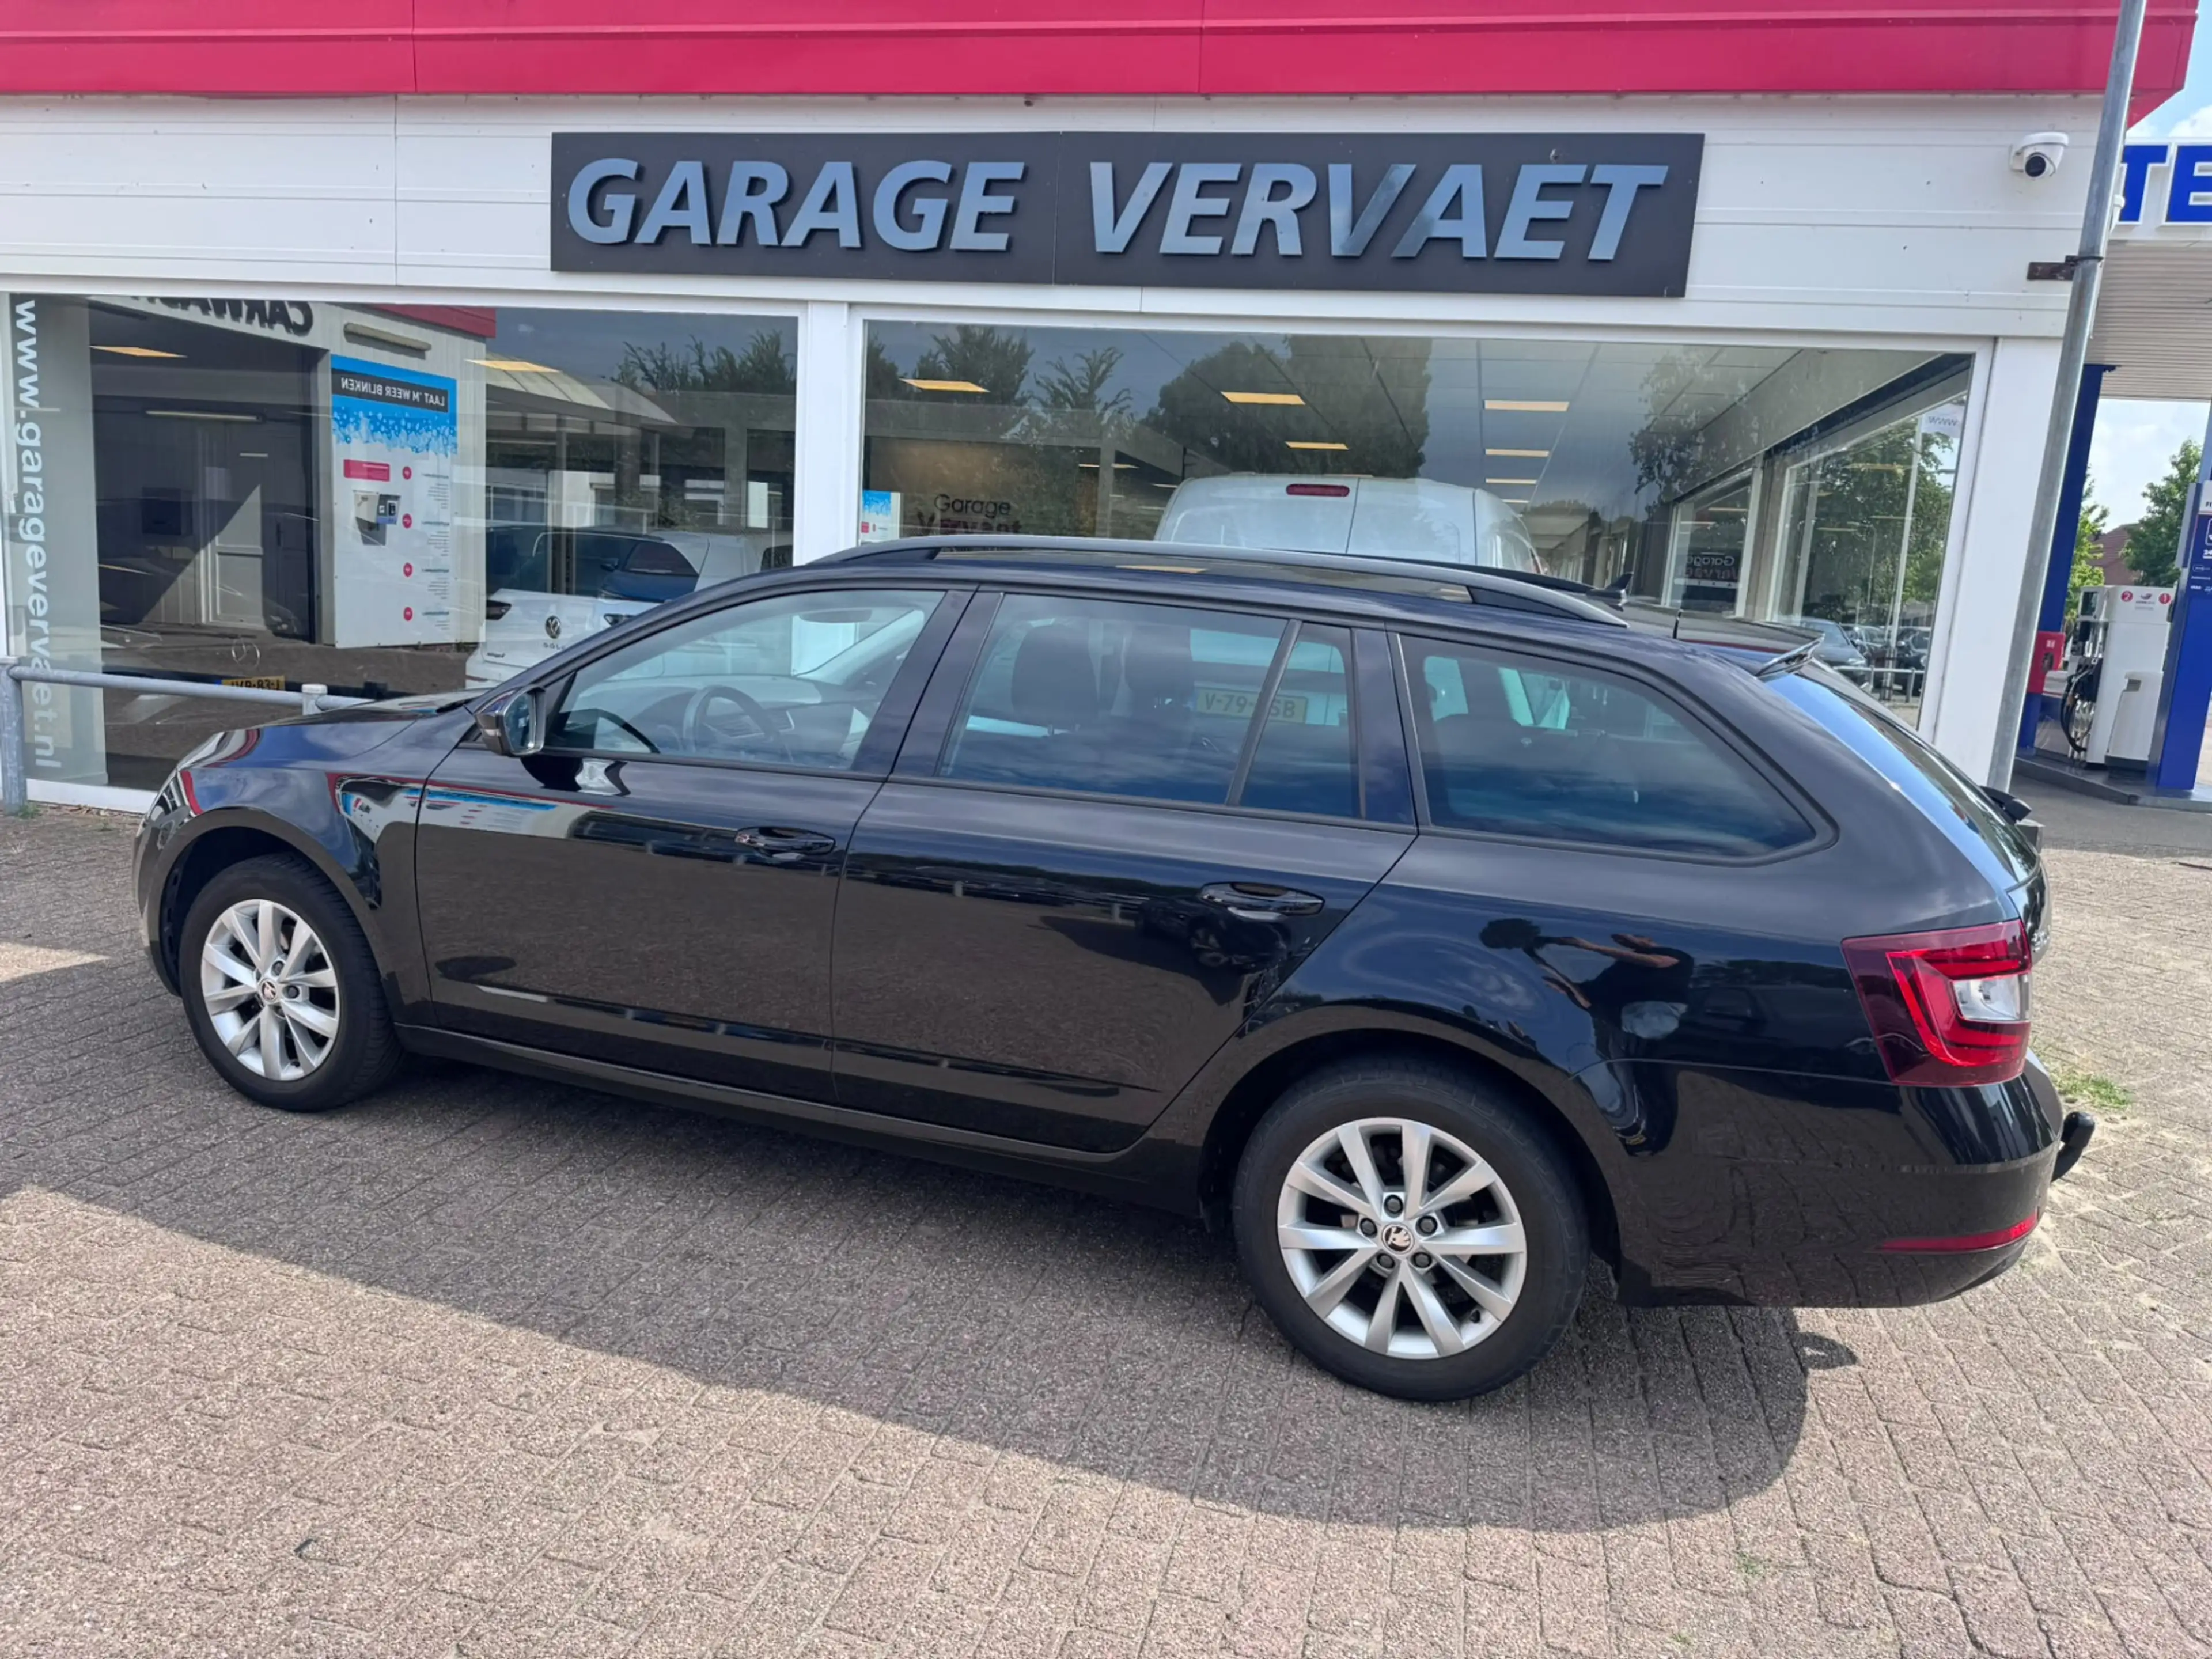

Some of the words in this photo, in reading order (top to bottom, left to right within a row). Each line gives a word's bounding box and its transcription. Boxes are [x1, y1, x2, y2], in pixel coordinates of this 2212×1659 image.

[567, 157, 1025, 252] GARAGE
[1089, 162, 1669, 260] VERVAET
[934, 494, 1011, 518] Garage
[1205, 692, 1296, 718] V-79-SB
